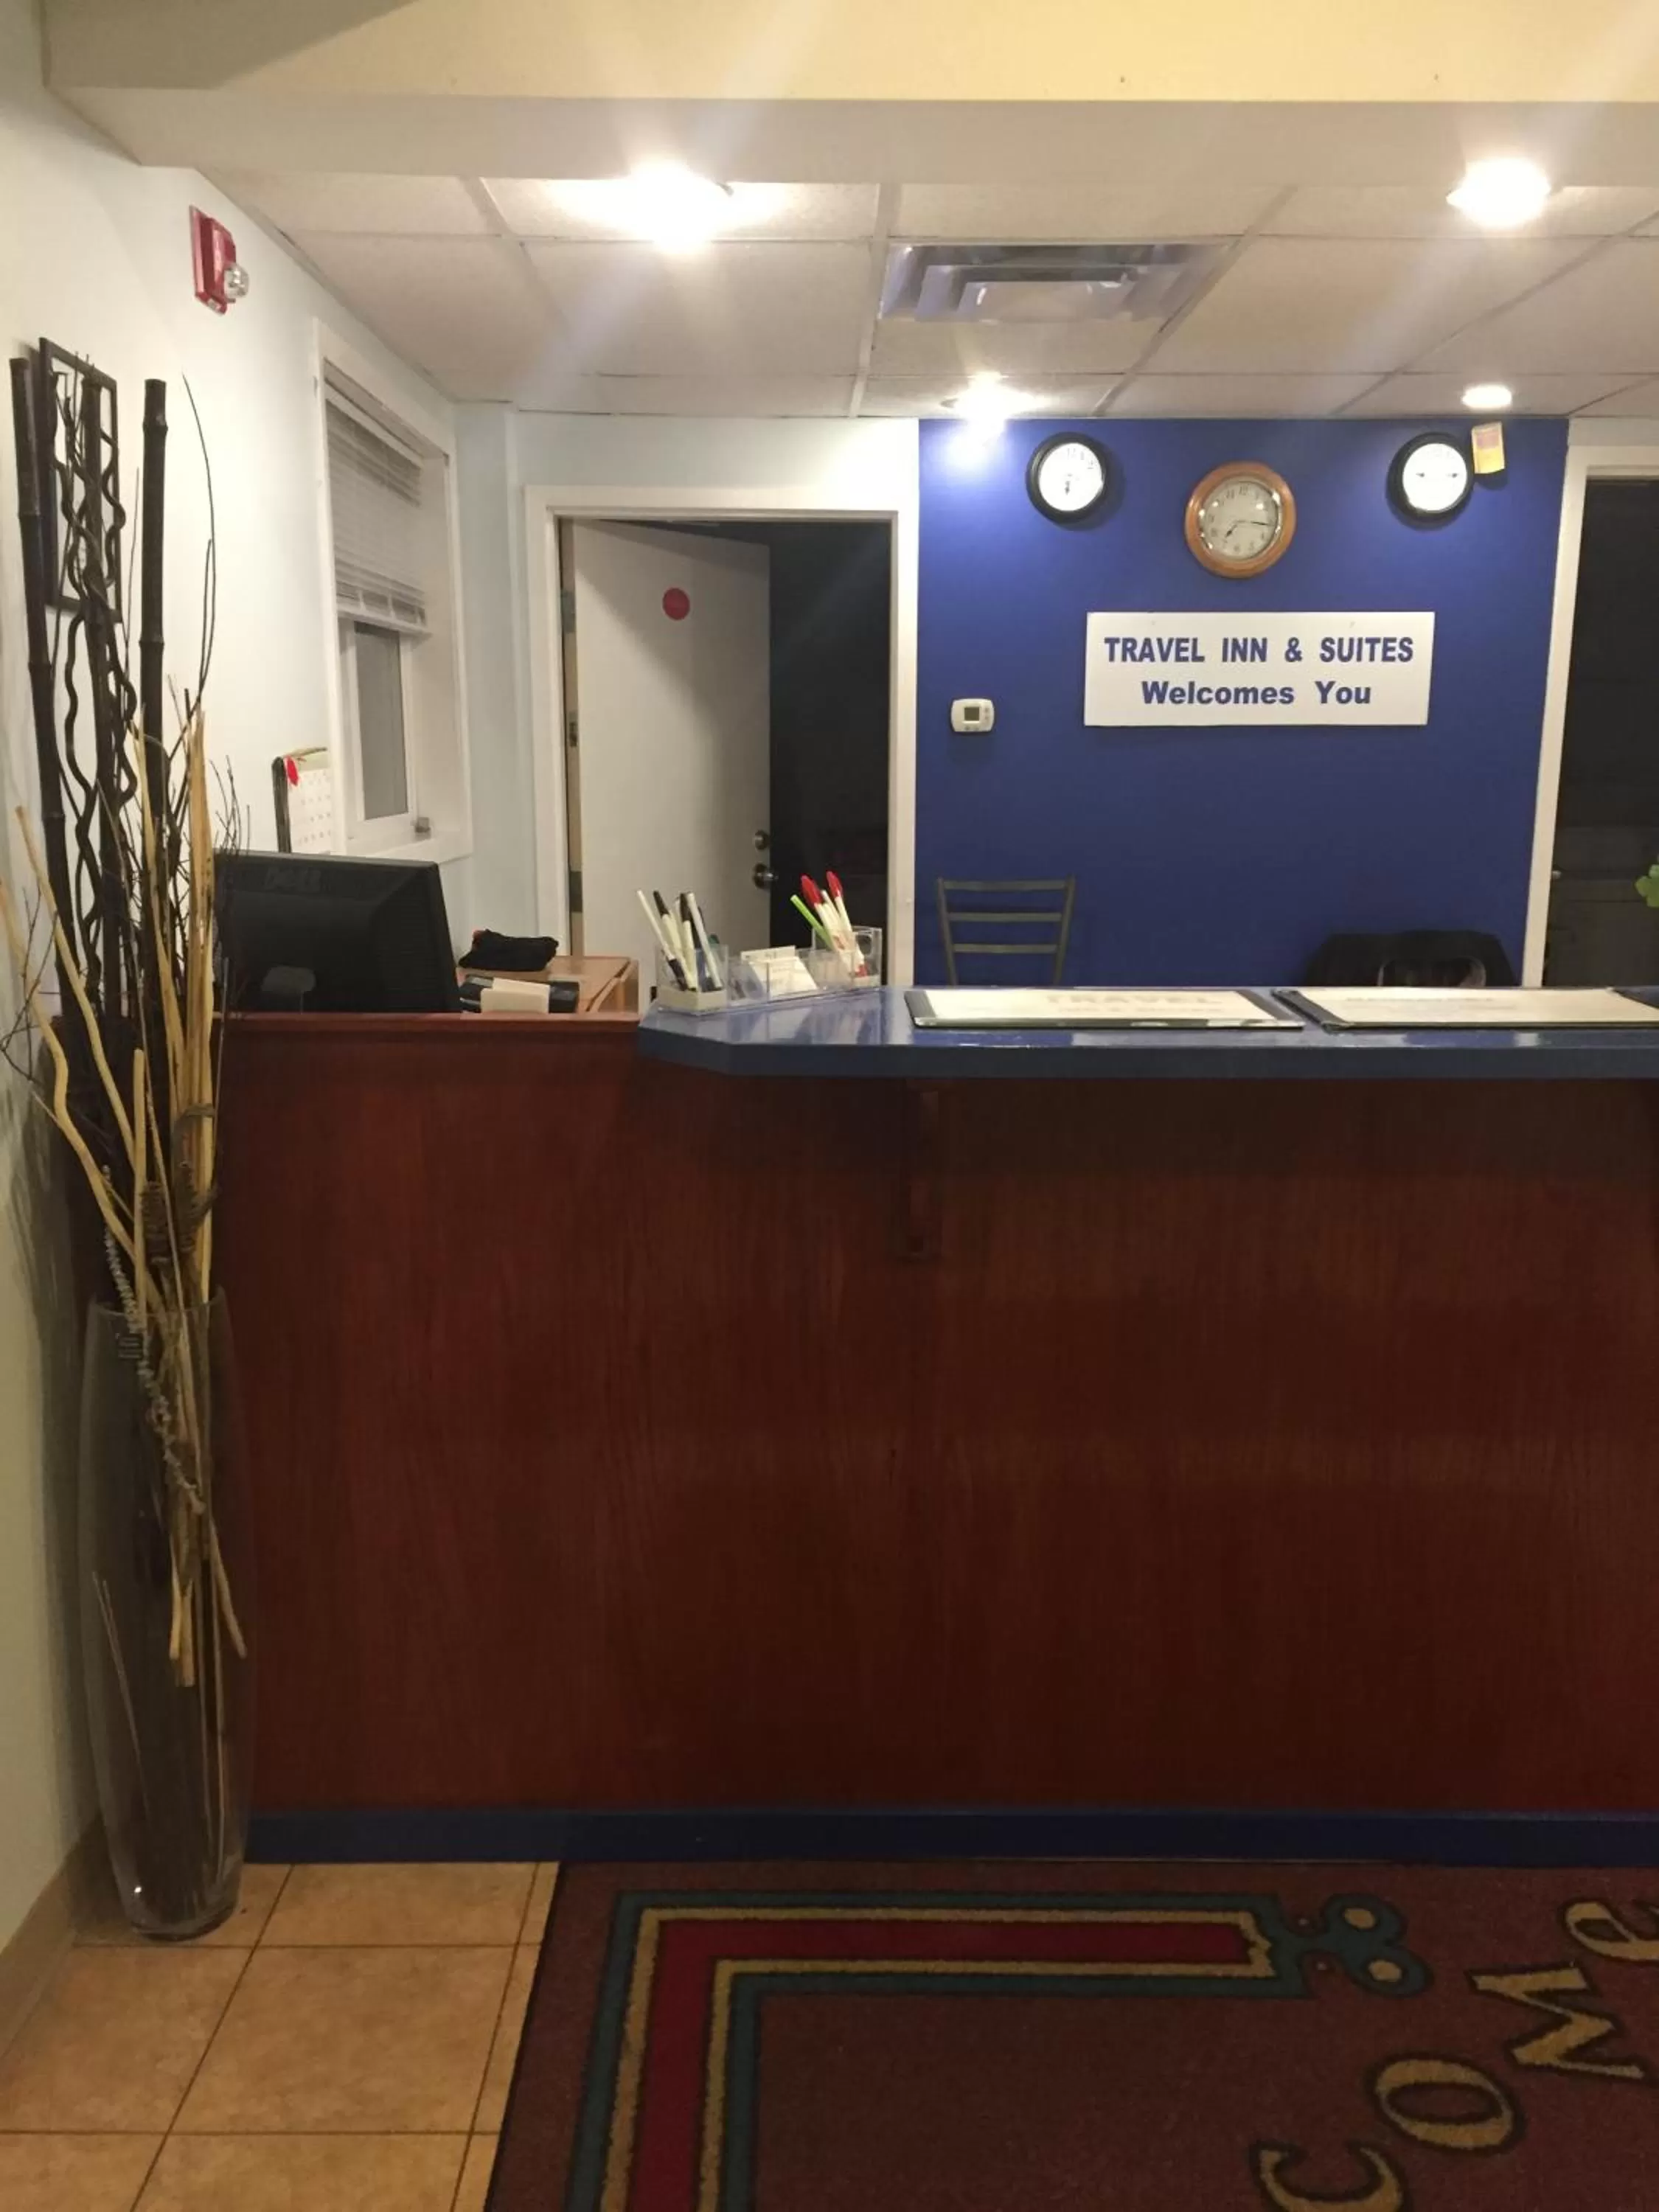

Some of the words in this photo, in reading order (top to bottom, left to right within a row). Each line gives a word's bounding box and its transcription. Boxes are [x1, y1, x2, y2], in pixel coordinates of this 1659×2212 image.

[1104, 637, 1206, 662] TRAVEL
[1222, 637, 1267, 662] INN
[1284, 637, 1303, 662] &
[1319, 637, 1413, 662] SUITES
[1141, 681, 1295, 704] Welcomes
[1315, 681, 1371, 704] You
